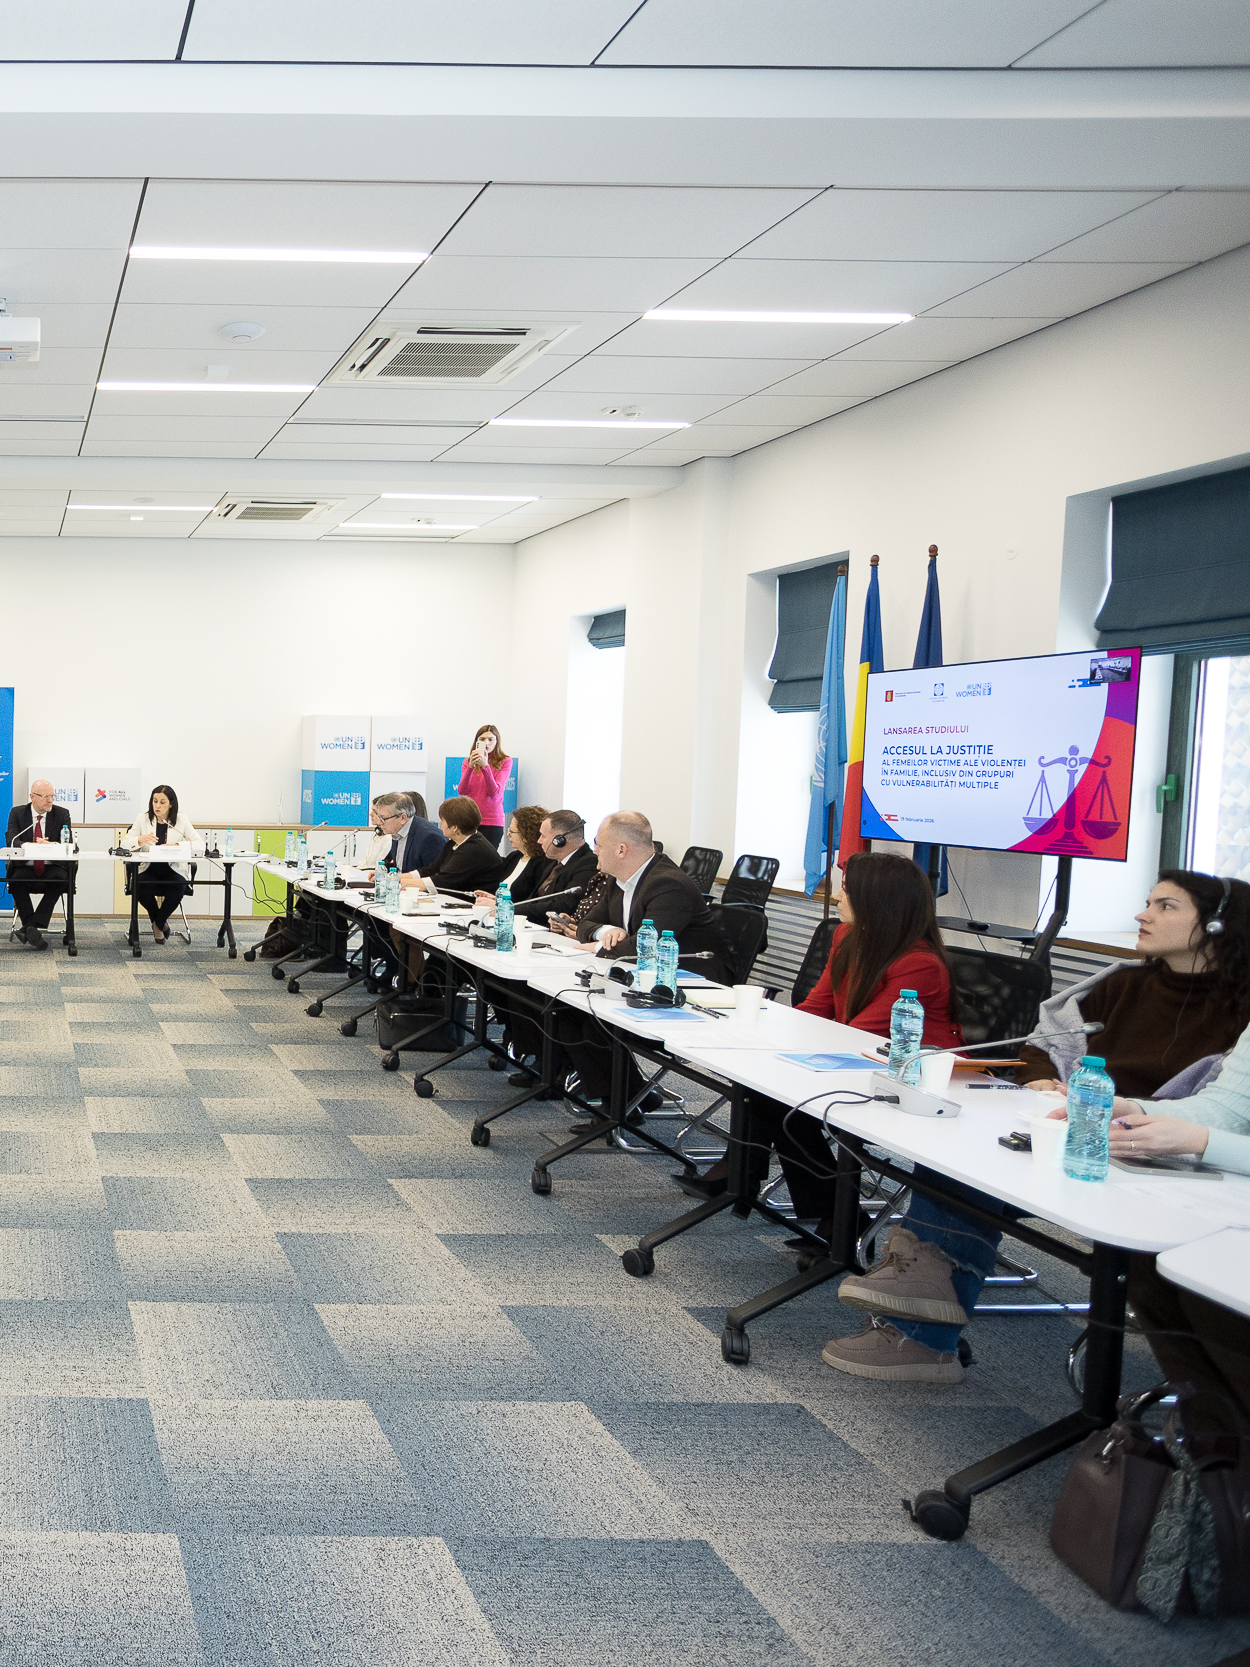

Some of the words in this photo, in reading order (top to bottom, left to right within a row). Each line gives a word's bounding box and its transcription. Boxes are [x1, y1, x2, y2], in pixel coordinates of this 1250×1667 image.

[955, 689, 982, 698] WOMEN
[883, 726, 924, 736] LANSAREA
[925, 725, 969, 734] STUDIULUI
[882, 745, 928, 756] ACCESUL
[930, 745, 944, 755] LA
[946, 744, 994, 758] JUSTIȚIE
[930, 759, 961, 767] VICTIME
[962, 759, 978, 767] ALE
[981, 759, 1026, 770] VIOLENȚEI
[881, 768, 888, 776] ÎN
[890, 769, 920, 778] FAMILIE,
[922, 769, 957, 777] INCLUSIV
[976, 770, 1014, 778] GRUPURI
[892, 778, 957, 790] VULNERABILITĂȚI
[958, 781, 999, 790] MULTIPLE
